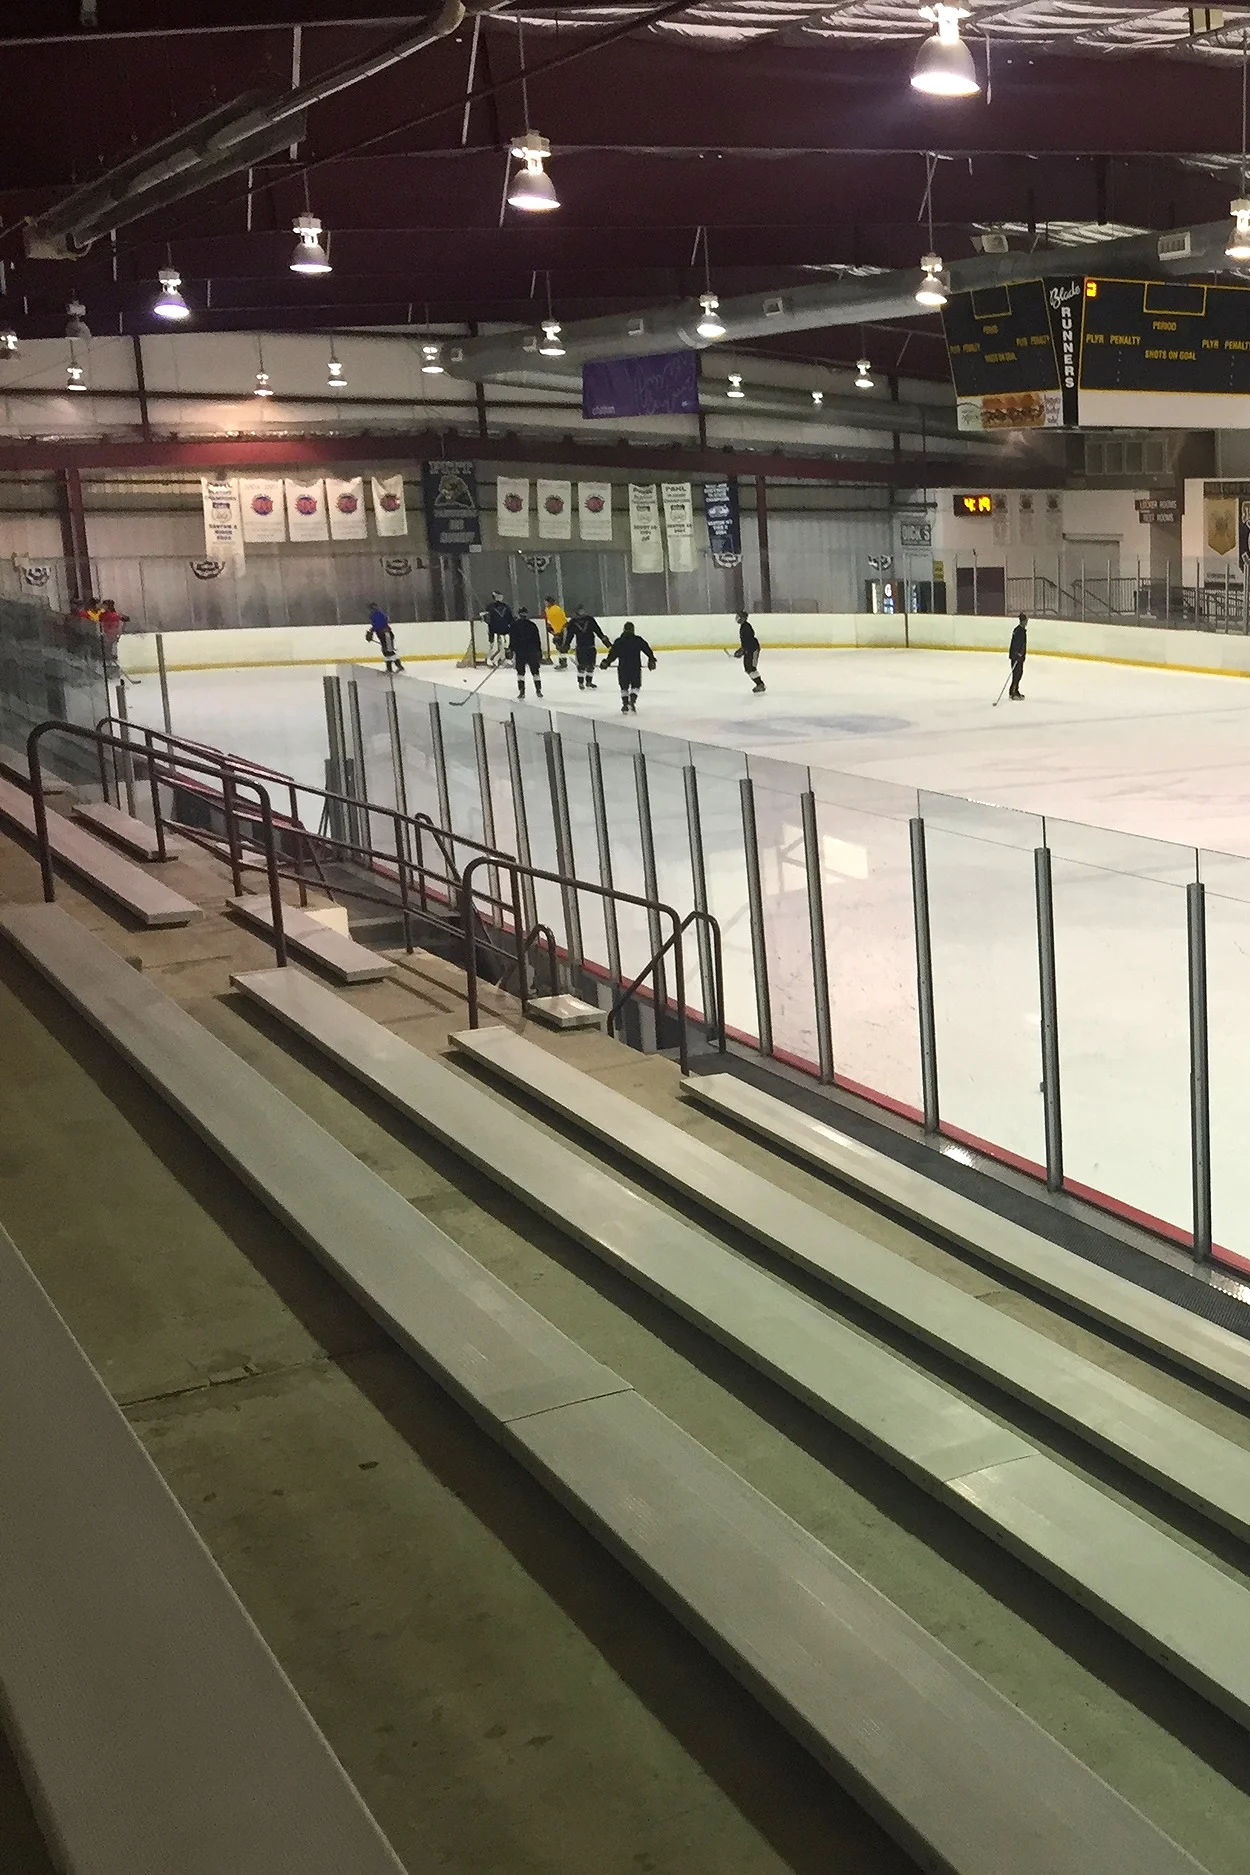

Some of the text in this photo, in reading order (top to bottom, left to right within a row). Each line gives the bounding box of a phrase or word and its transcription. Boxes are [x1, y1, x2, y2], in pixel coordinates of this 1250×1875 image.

[1050, 281, 1081, 309] Blade
[1152, 320, 1177, 331] PERIOD
[1085, 333, 1141, 346] PLYR PENALTY
[1201, 339, 1219, 349] PLYR
[1061, 306, 1075, 389] RUNNERS
[1144, 349, 1197, 361] SHOTS ON GOAL
[1159, 500, 1177, 510] ROOMS
[1156, 512, 1174, 523] ROOMS
